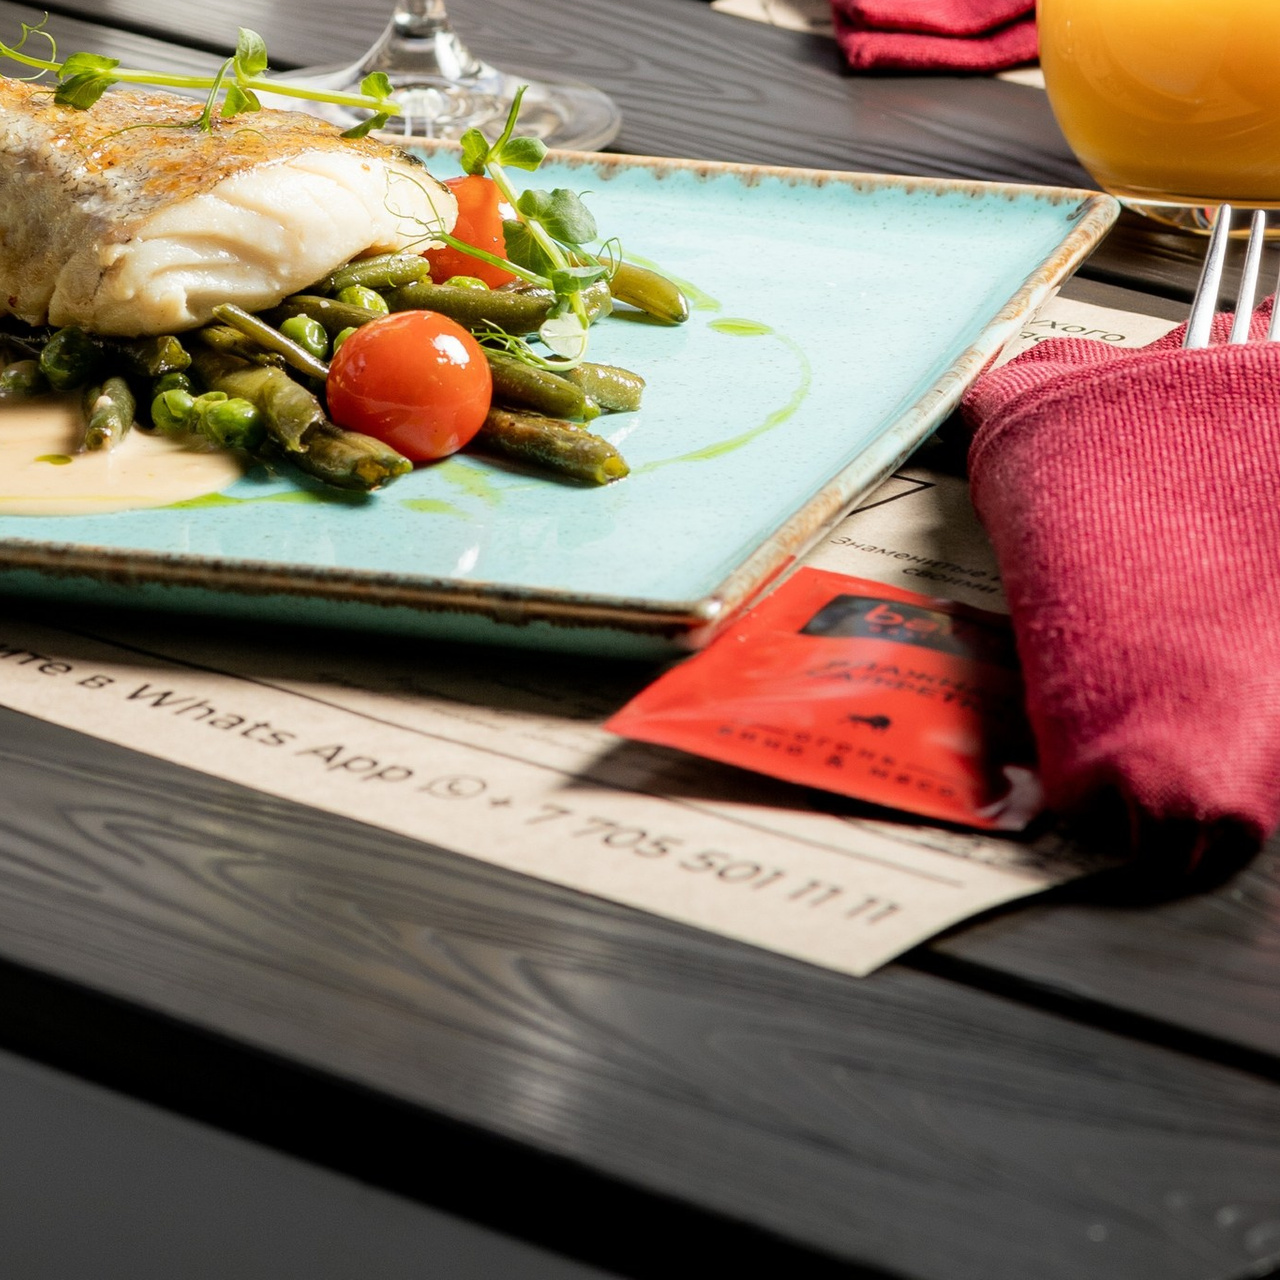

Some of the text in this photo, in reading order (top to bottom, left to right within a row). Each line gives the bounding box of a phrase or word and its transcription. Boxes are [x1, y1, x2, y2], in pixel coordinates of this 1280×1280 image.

[127, 683, 298, 747] Whats
[295, 744, 414, 783] App
[526, 803, 572, 825] 7
[572, 815, 682, 860] 705
[679, 850, 787, 892] 501
[788, 879, 844, 909] 11
[845, 896, 901, 926] 11
